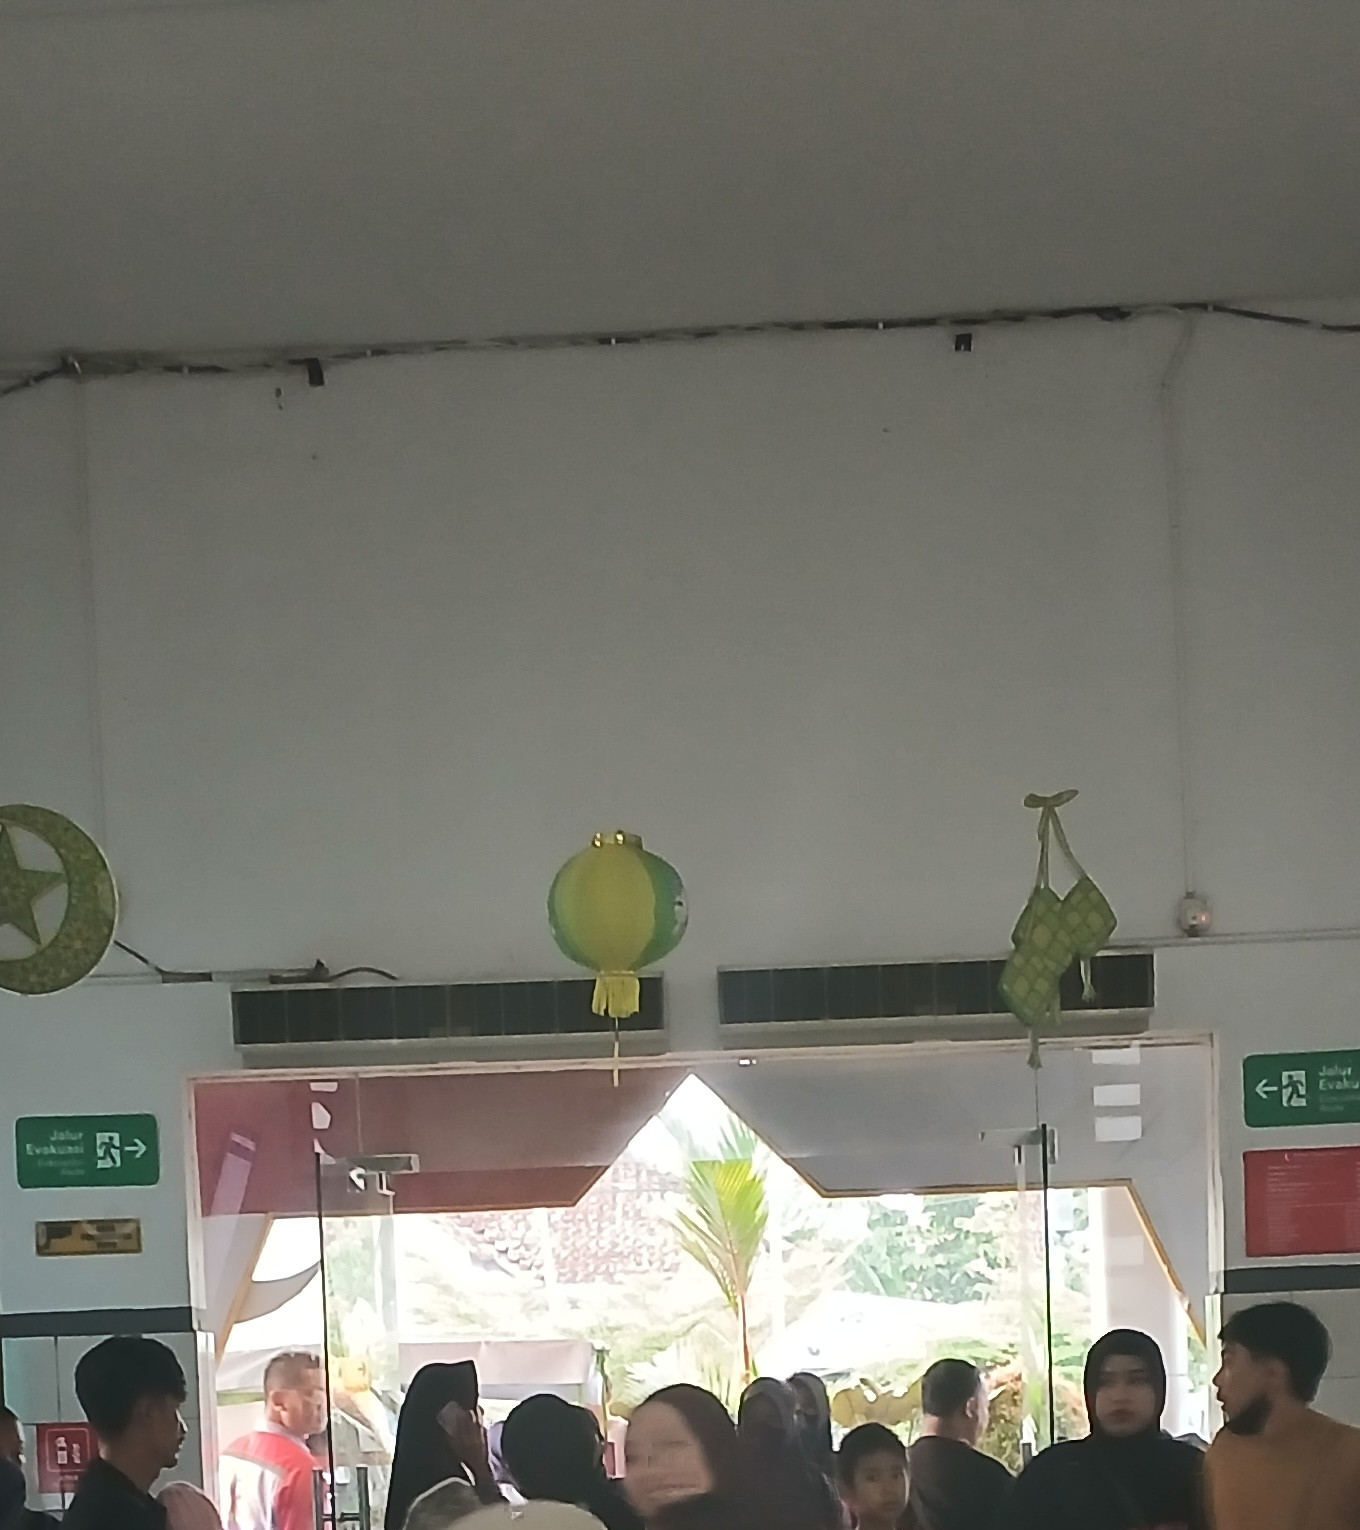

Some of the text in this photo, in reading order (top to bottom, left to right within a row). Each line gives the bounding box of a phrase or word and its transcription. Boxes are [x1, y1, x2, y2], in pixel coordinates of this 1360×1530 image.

[1318, 1063, 1352, 1076] Jalur
[50, 1129, 83, 1141] Jalur
[25, 1143, 84, 1156] Evakuasi
